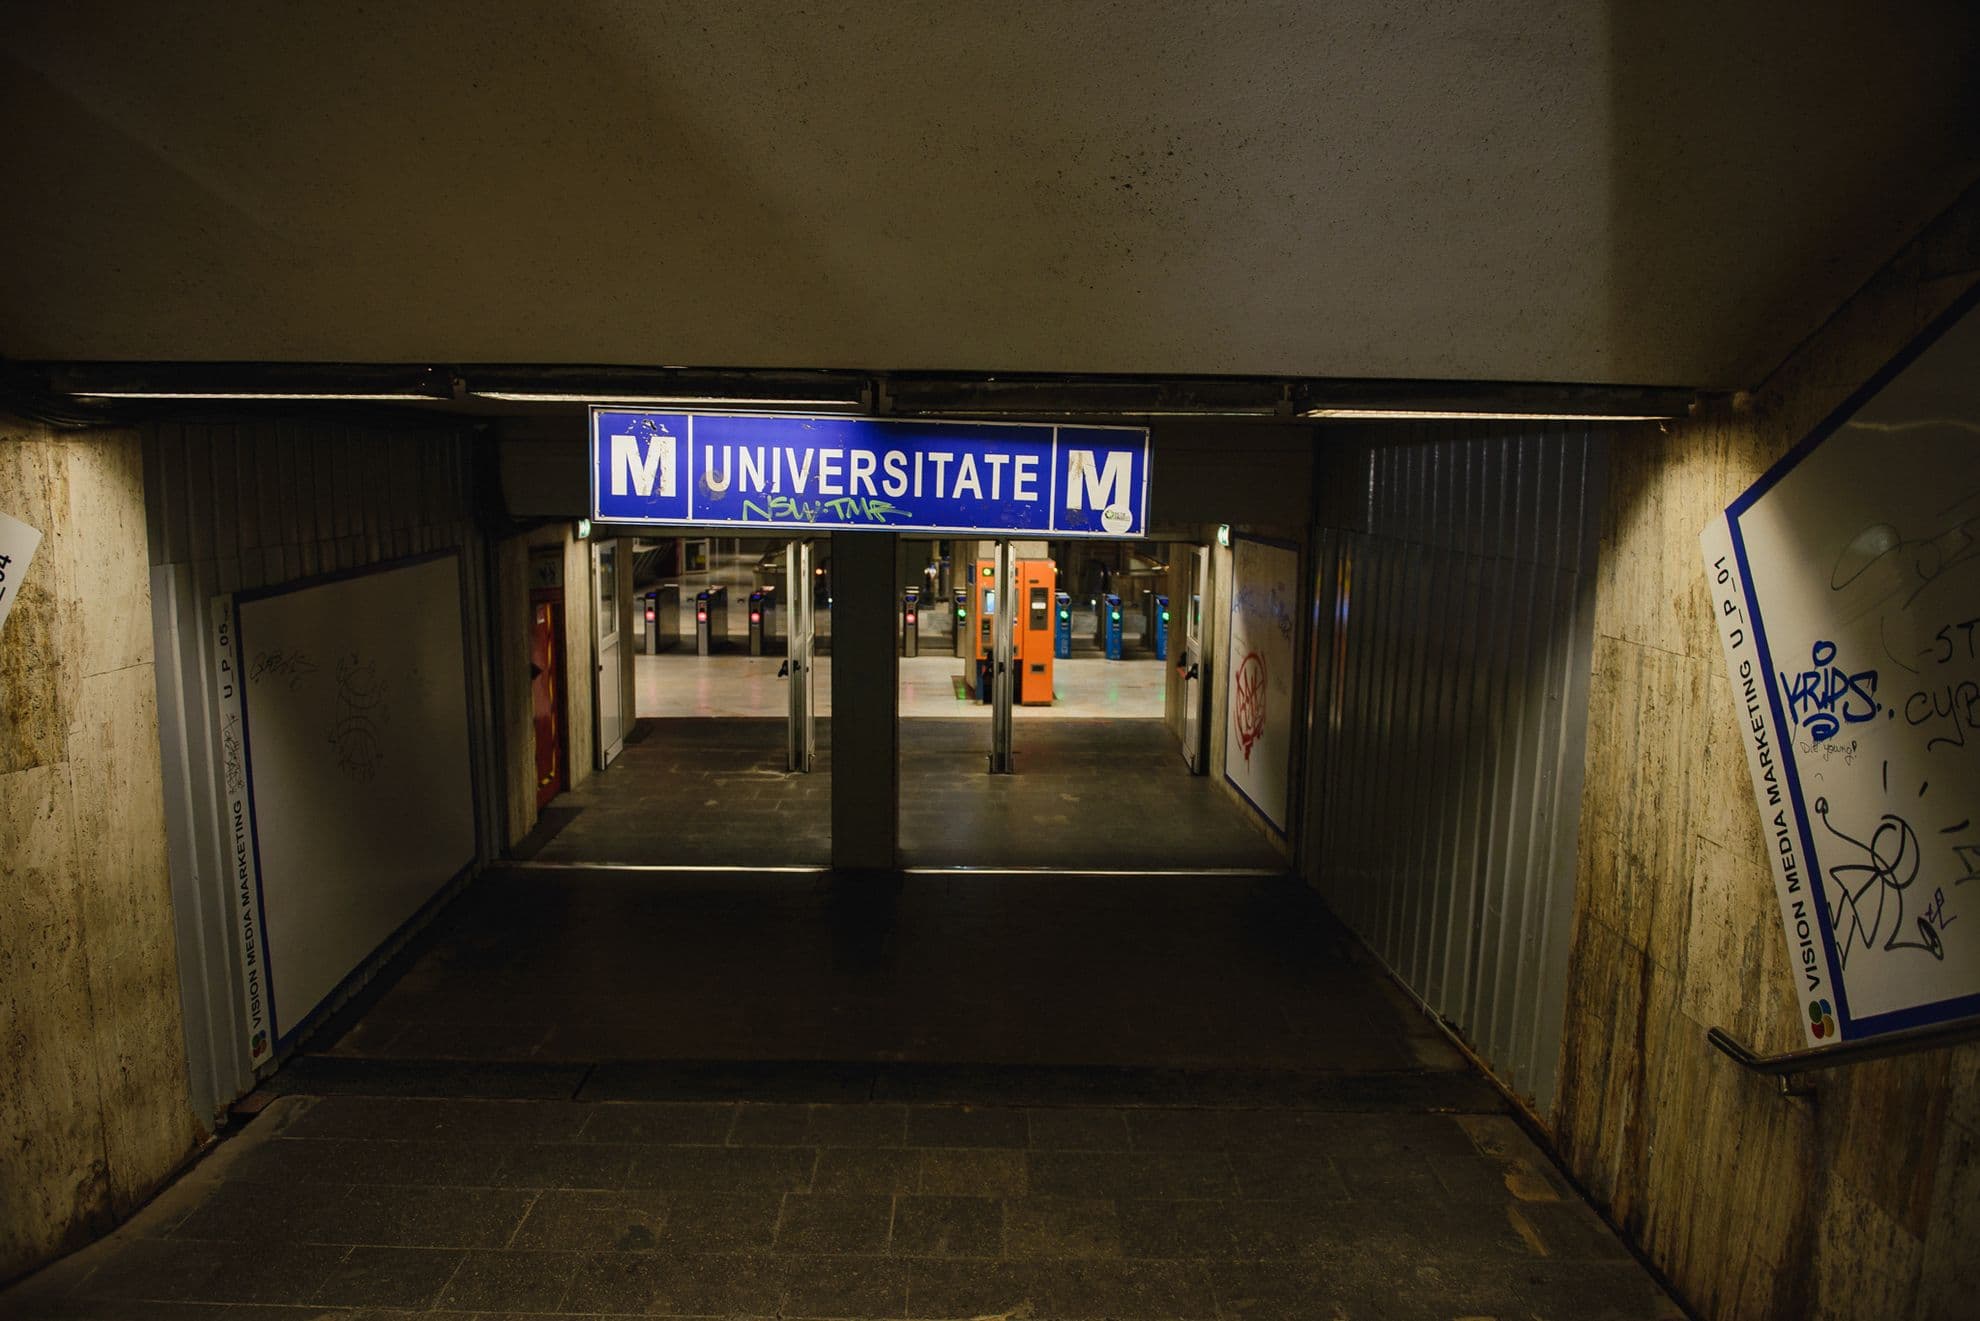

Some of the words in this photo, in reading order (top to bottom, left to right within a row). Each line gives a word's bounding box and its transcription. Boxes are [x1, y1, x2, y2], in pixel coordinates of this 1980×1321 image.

[611, 434, 677, 498] M
[704, 444, 1040, 502] UNIVERSITATE
[1066, 449, 1133, 512] M
[1739, 660, 1782, 805] MARKETING
[233, 800, 251, 907] MARKETING
[1773, 810, 1801, 892] MEDIA
[243, 908, 256, 965] MEDIA
[1791, 901, 1821, 991] VISION
[249, 968, 262, 1028] VISION
